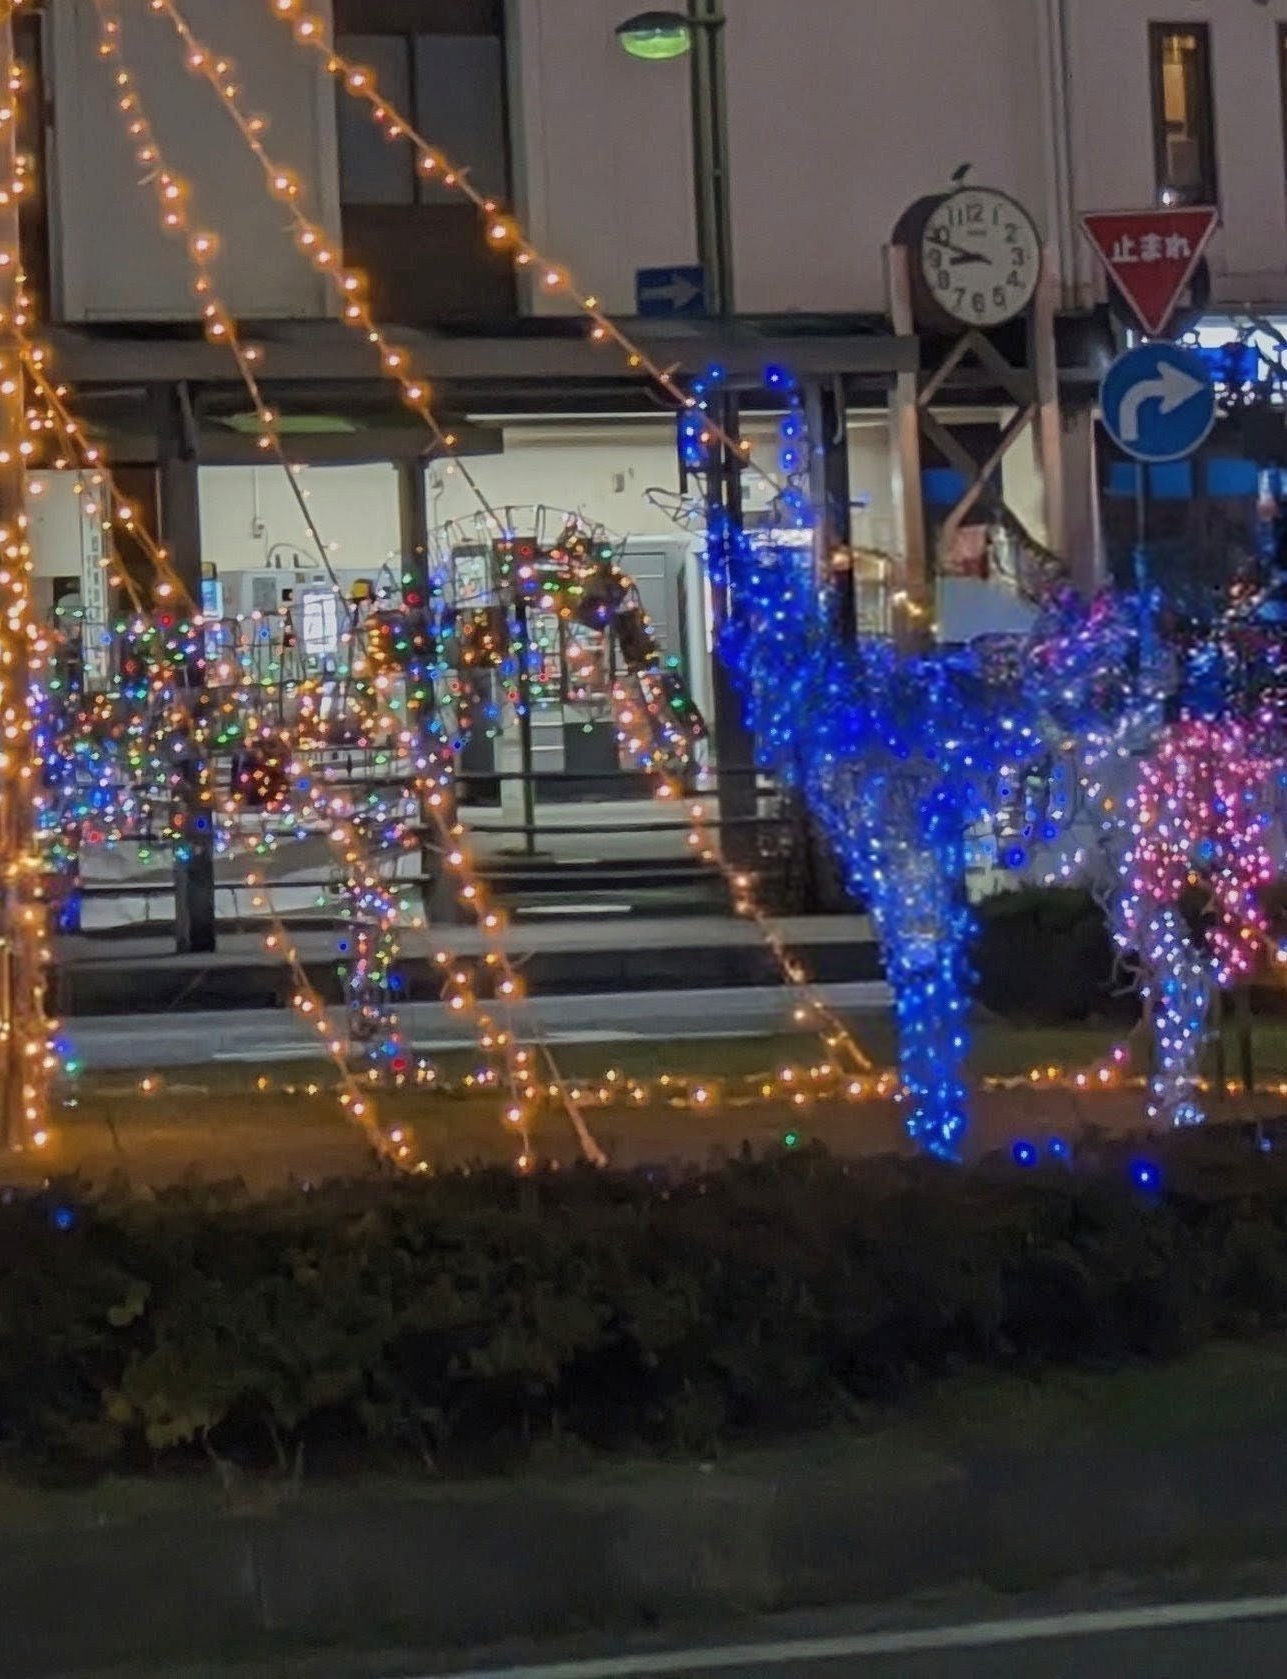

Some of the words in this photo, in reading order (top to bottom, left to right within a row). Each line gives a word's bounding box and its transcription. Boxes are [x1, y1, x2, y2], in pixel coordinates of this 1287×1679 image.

[1011, 247, 1025, 266] 3
[1111, 233, 1191, 263] 止まれ
